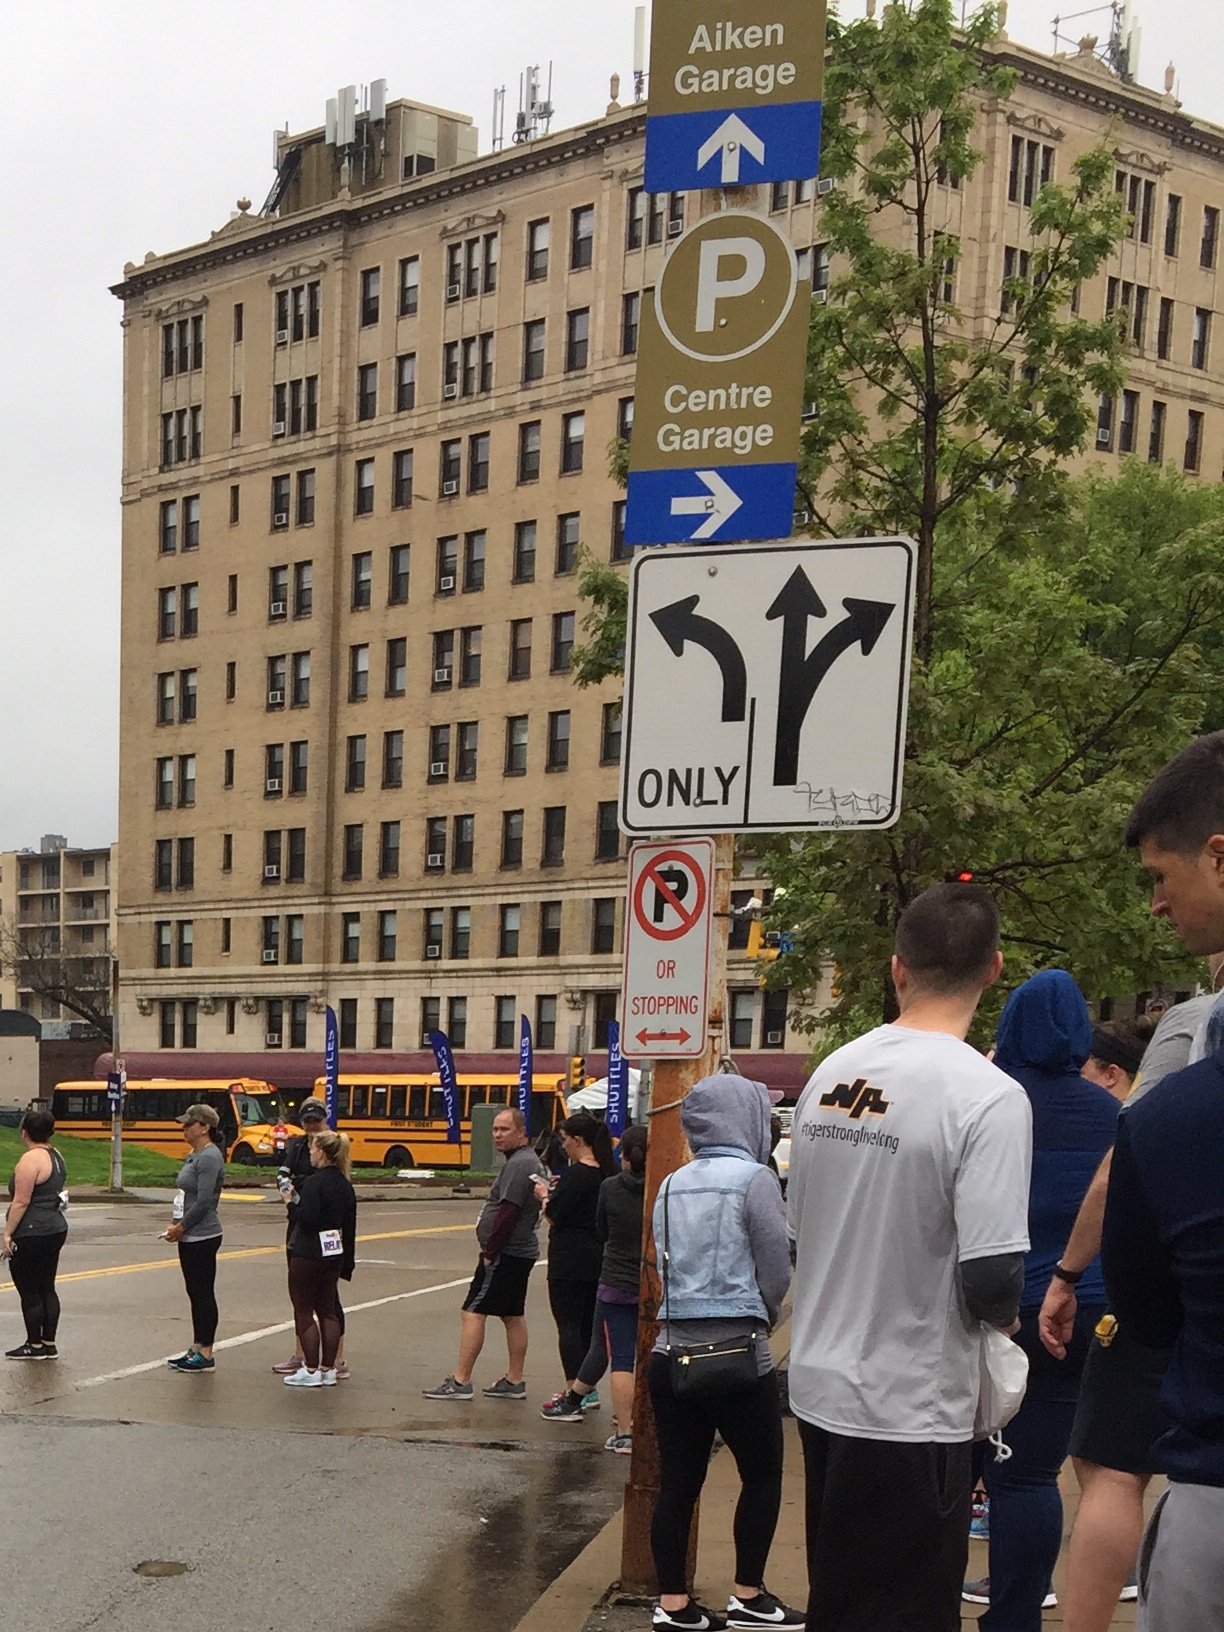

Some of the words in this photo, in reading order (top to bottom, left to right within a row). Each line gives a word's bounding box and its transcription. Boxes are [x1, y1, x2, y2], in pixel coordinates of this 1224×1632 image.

[688, 21, 785, 55] Aiken
[674, 59, 796, 95] Garage
[695, 236, 766, 333] P
[664, 383, 772, 414] Centre
[657, 422, 774, 455] Garage
[637, 765, 740, 809] ONLY
[656, 959, 677, 979] OR
[631, 995, 699, 1015] STOPPING
[609, 1042, 622, 1124] SHUTTLES
[390, 1120, 405, 1128] FIRST
[407, 1120, 434, 1128] STUDENT
[801, 1120, 900, 1154] #tigerstronglivelong
